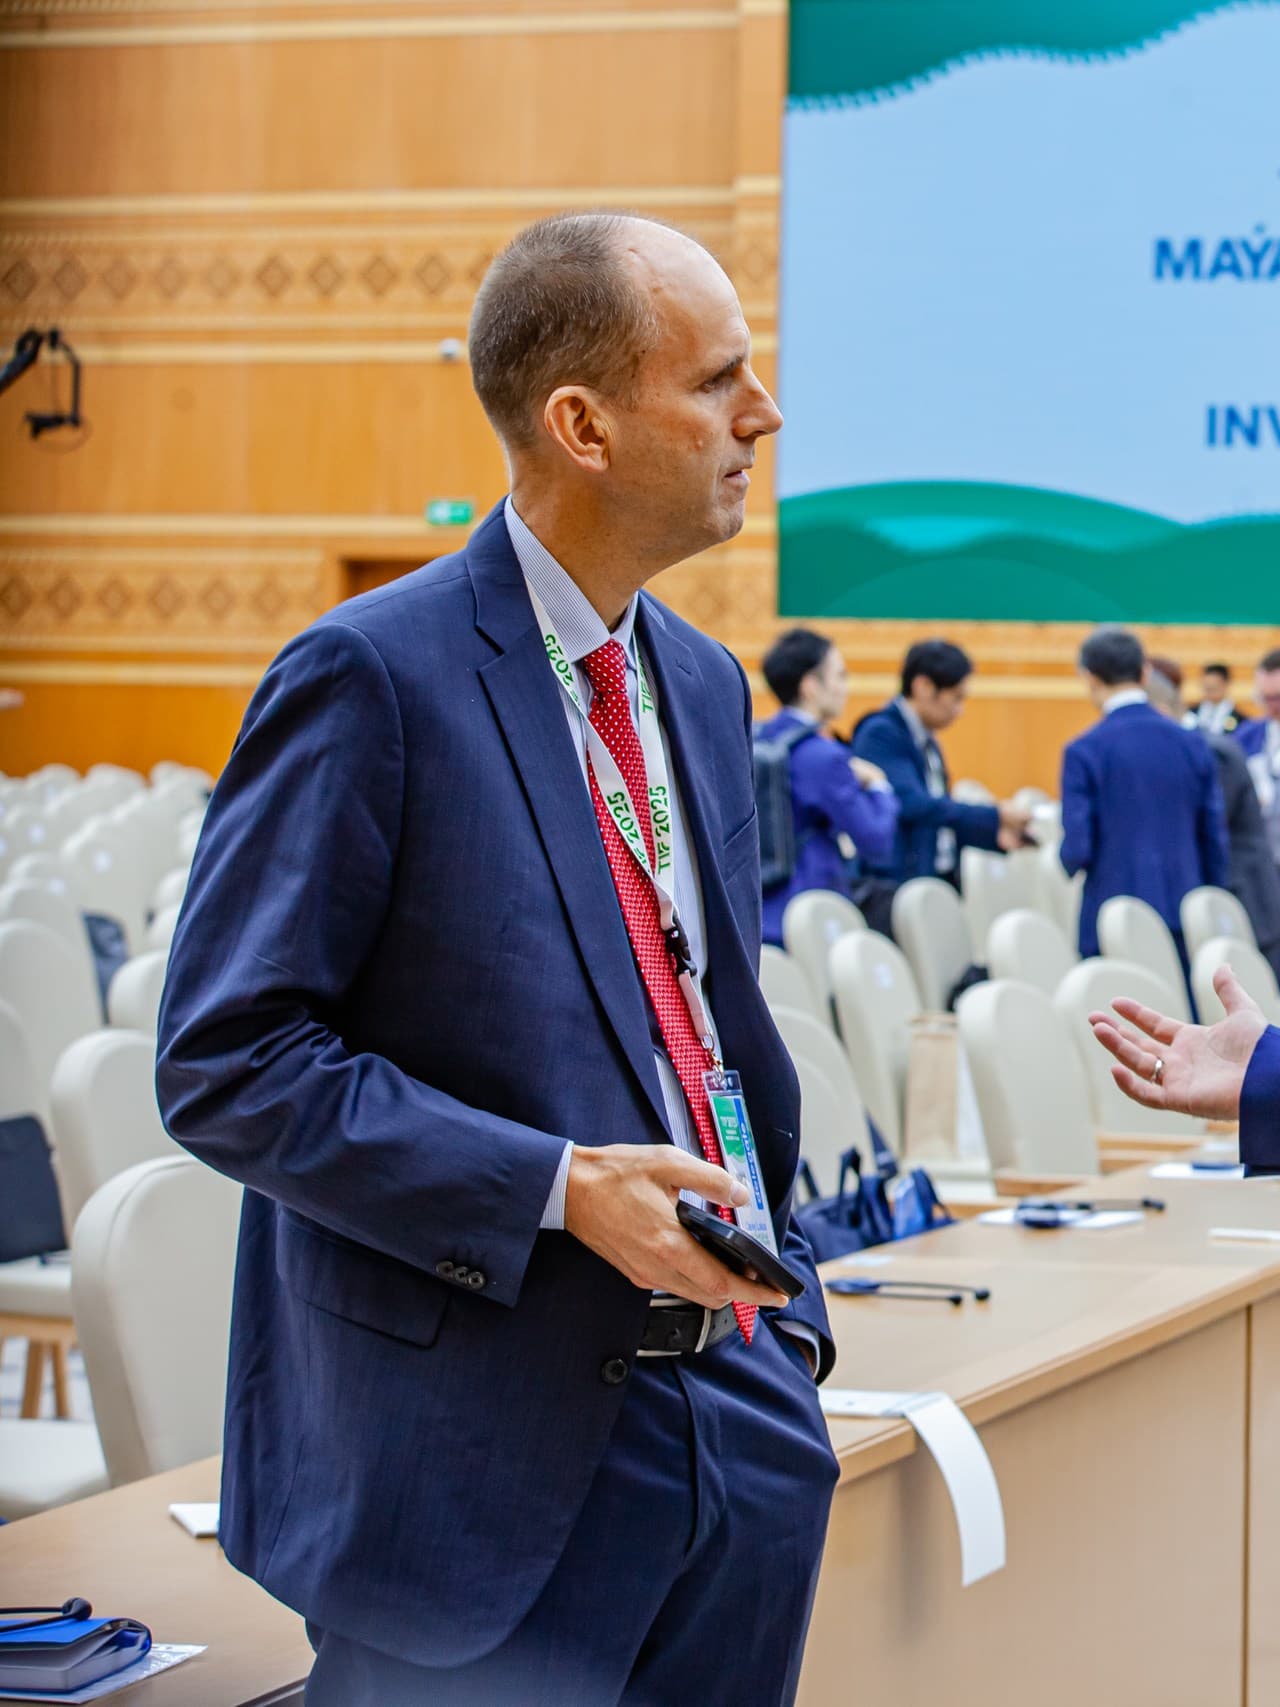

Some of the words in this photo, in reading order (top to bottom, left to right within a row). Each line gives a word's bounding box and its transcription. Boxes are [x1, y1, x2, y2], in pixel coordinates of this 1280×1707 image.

[544, 634, 574, 686] 2025
[606, 791, 640, 844] 2025
[649, 786, 671, 837] 2025
[657, 842, 671, 875] TIF
